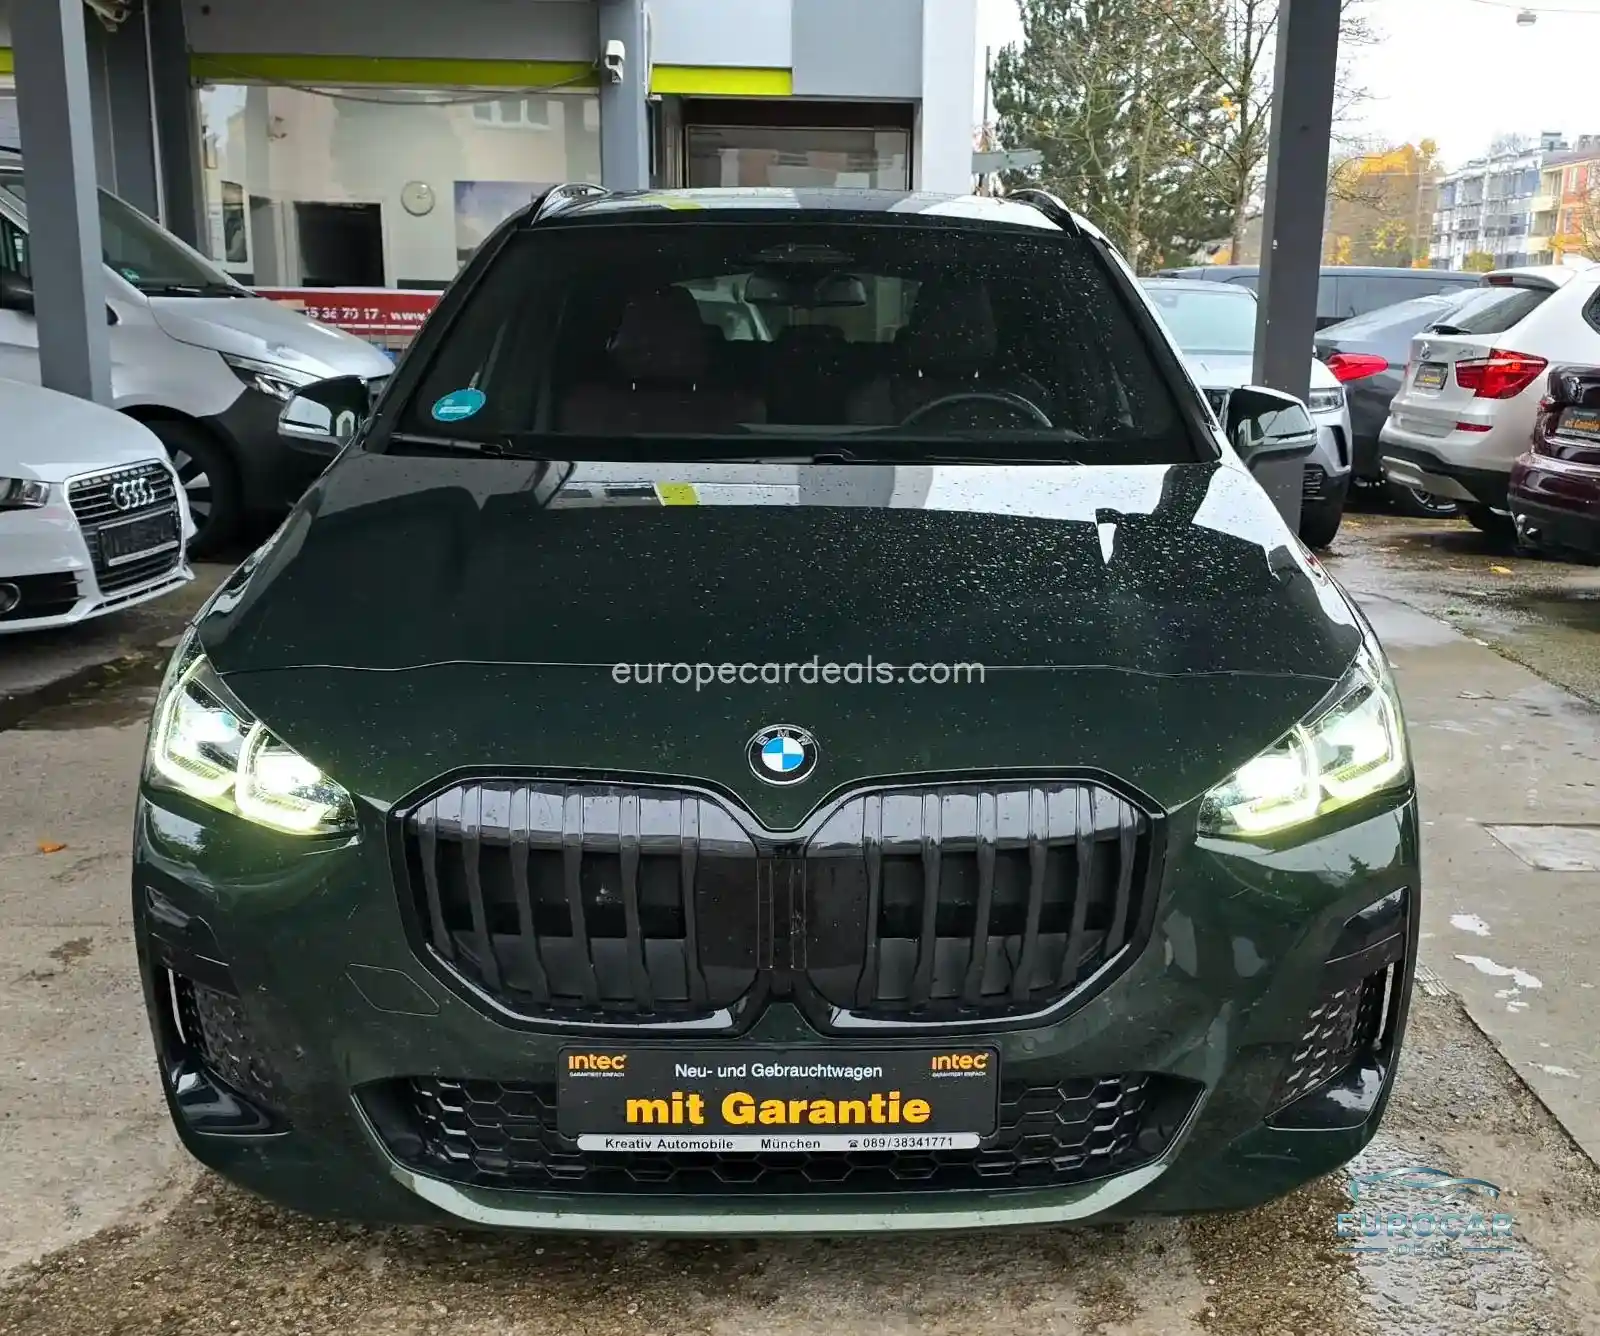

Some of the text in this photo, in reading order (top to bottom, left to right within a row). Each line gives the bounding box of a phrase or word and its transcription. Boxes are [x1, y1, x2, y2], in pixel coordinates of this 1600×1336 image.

[363, 307, 379, 320] 17
[755, 729, 813, 746] BMW
[675, 1063, 883, 1081] Neu- und Gebrauchtwagen
[626, 1090, 931, 1125] mit Garantie
[605, 1136, 953, 1149] Kreativ Automobile München 089/38341771
